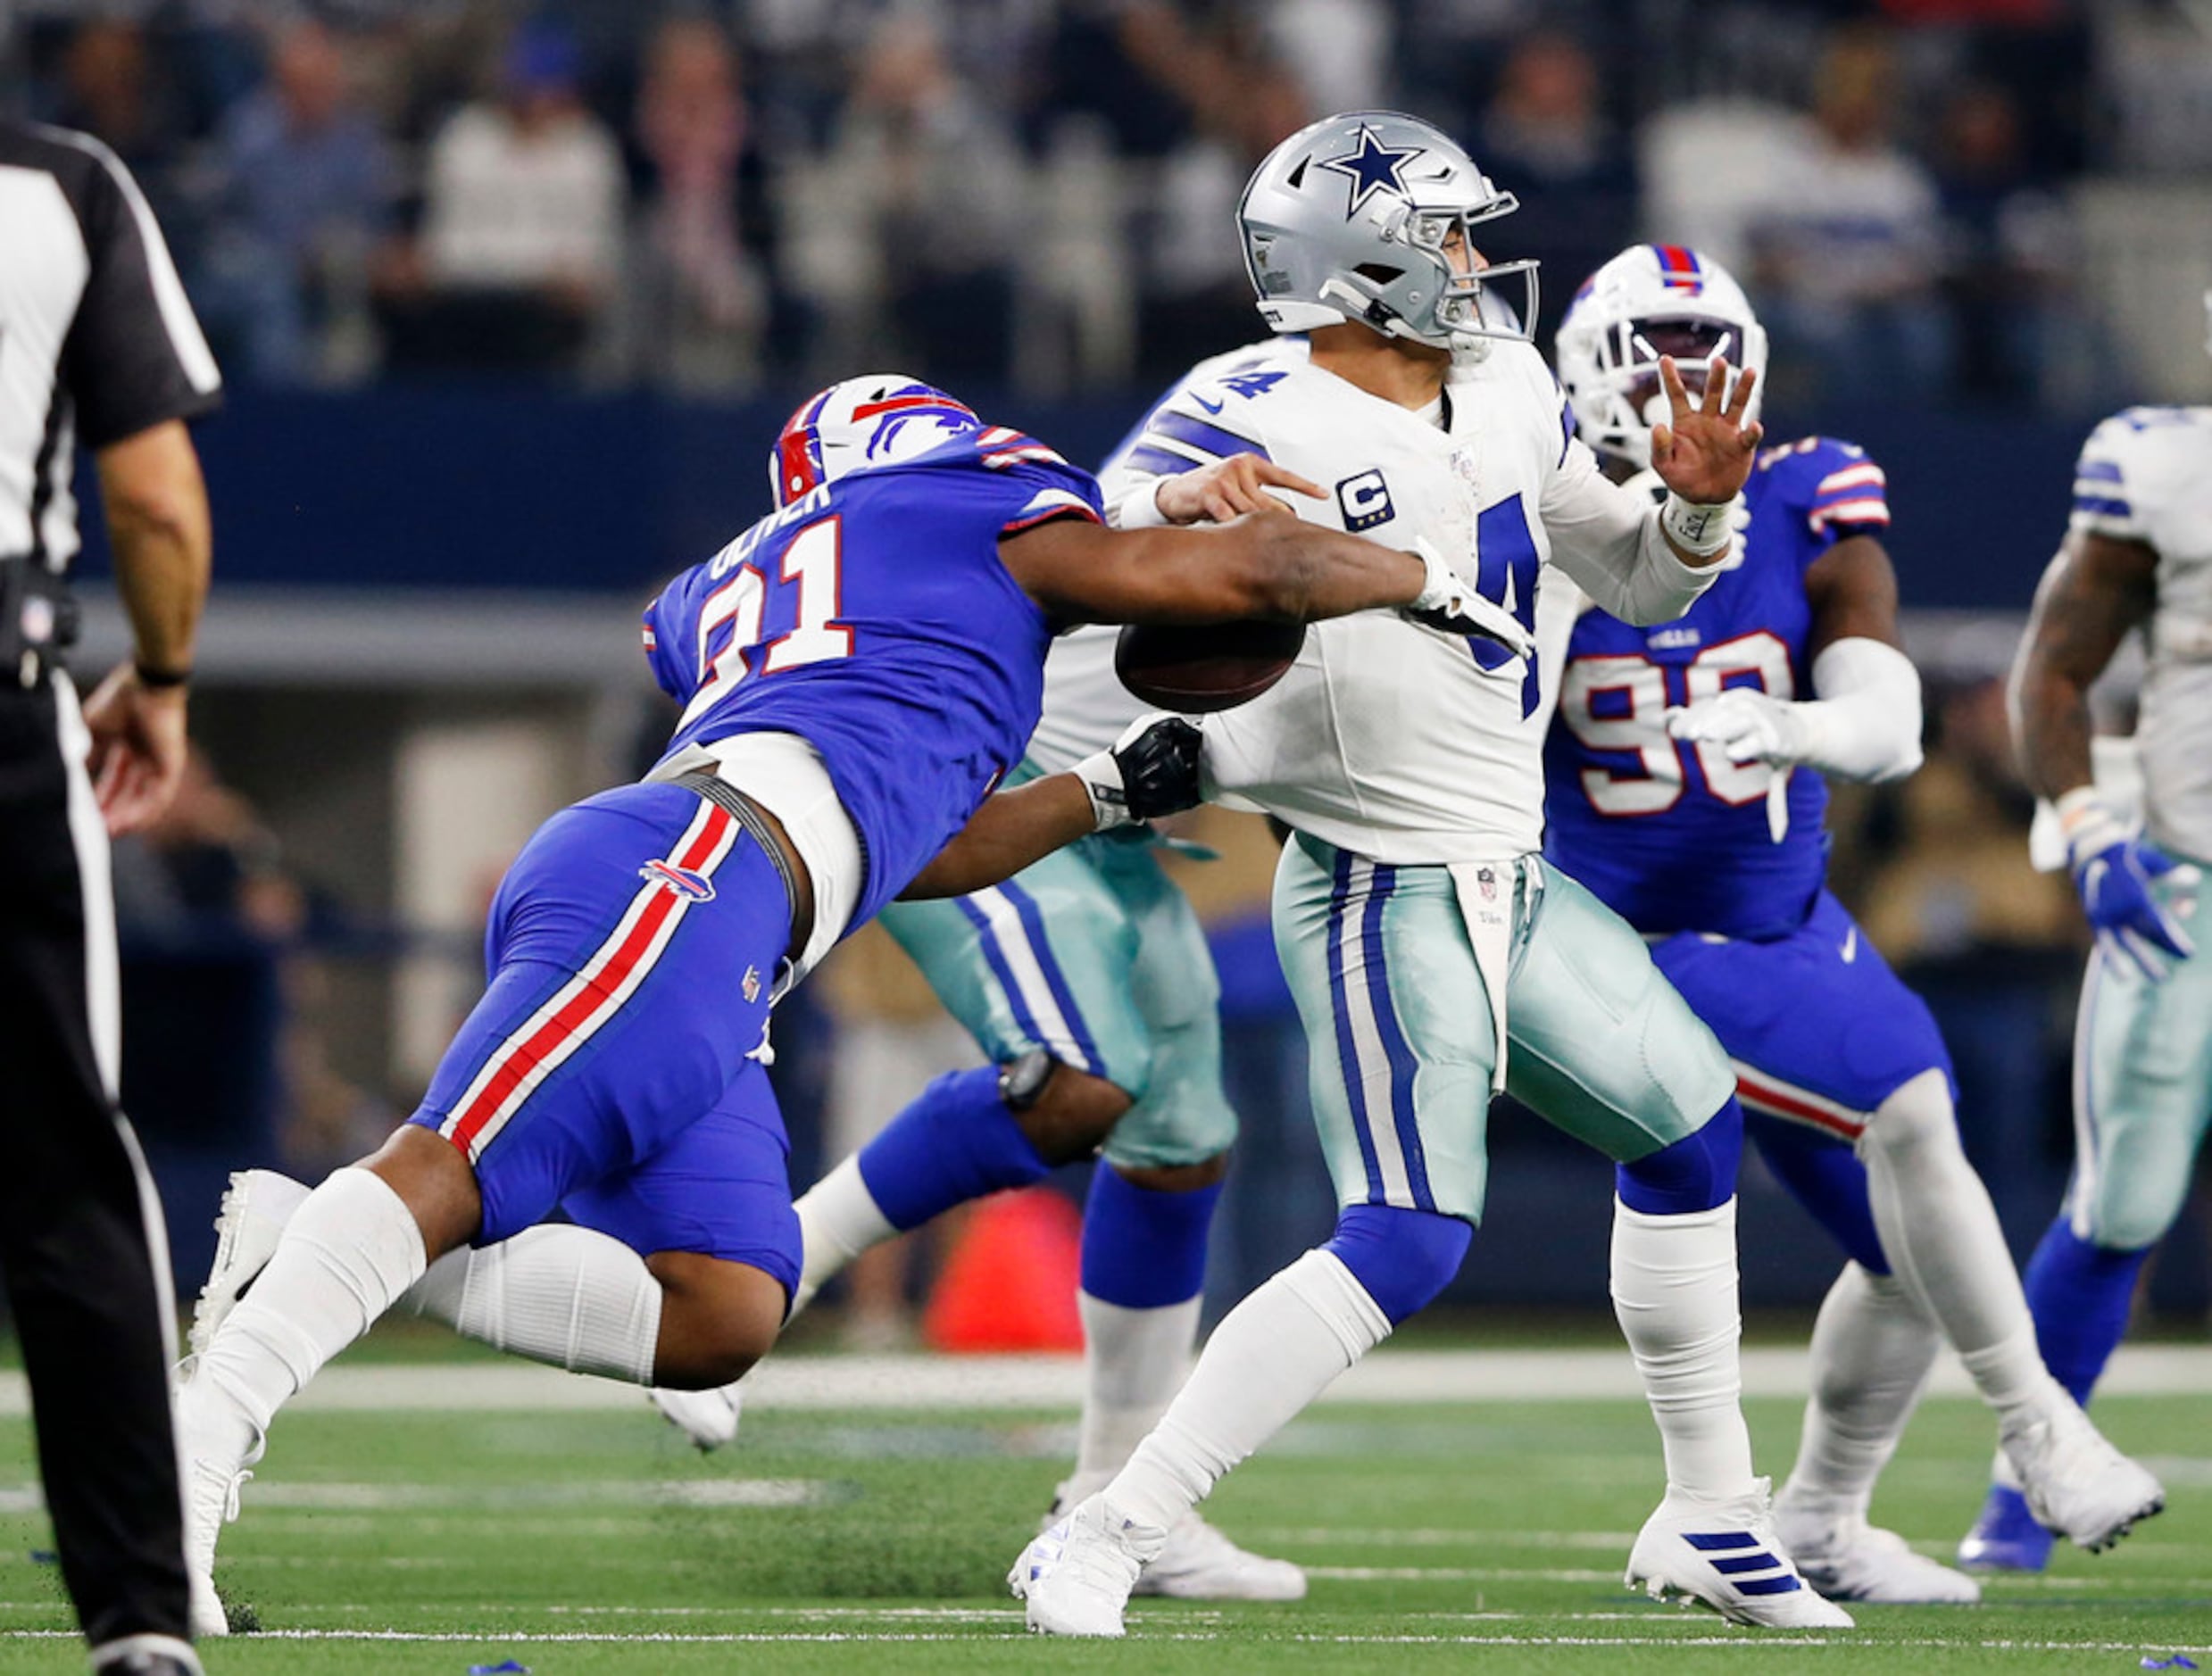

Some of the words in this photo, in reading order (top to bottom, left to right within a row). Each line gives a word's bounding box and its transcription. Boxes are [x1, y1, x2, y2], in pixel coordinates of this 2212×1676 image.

[1340, 473, 1389, 519] C
[675, 512, 854, 734] 91
[1464, 491, 1541, 721] 4
[1560, 628, 1794, 817] 90
